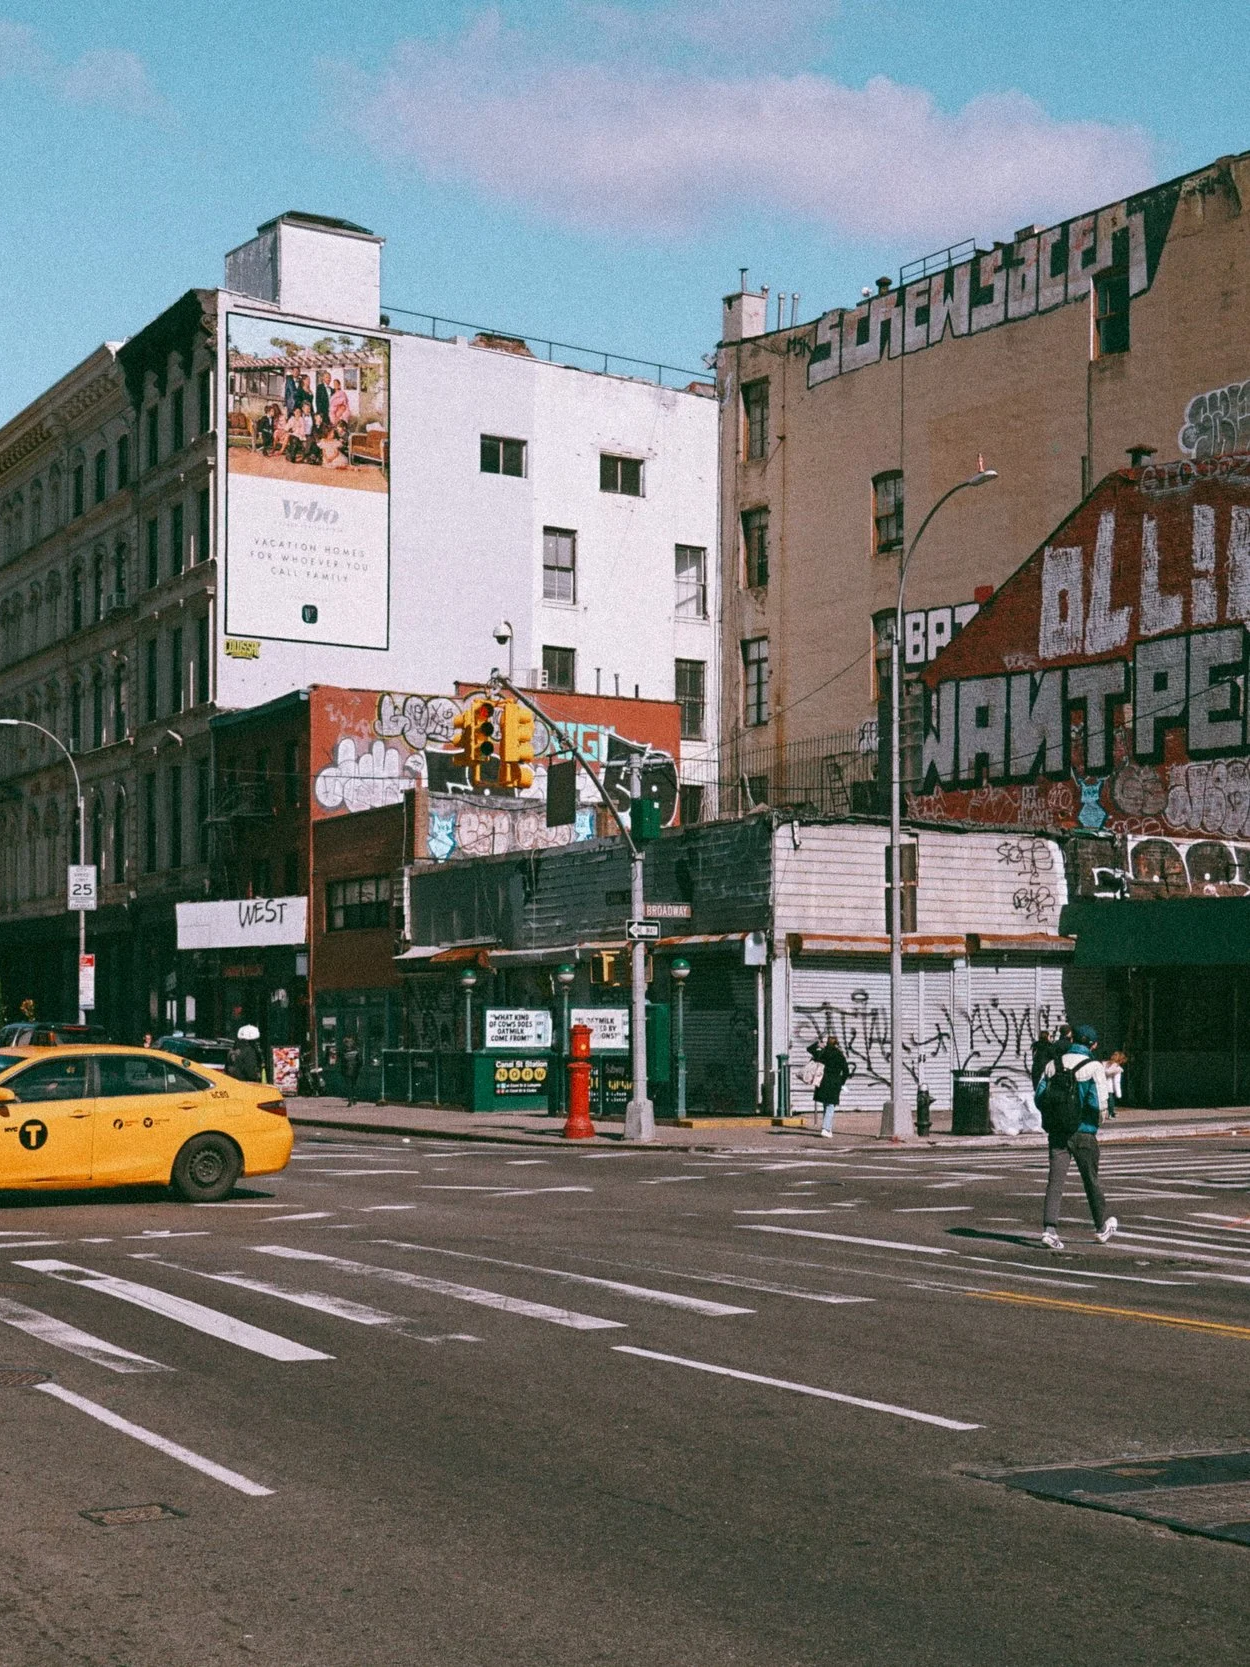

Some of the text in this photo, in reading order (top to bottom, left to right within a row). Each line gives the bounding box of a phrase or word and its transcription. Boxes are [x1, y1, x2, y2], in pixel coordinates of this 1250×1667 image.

[283, 499, 339, 525] Vrbo
[254, 538, 365, 558] VACATION HOMES
[250, 551, 368, 572] FOR WHOEVER YOU
[271, 567, 348, 583] CALL FAMILY
[73, 884, 93, 896] 25
[239, 900, 288, 928] WEST
[646, 904, 688, 916] BROADWAY
